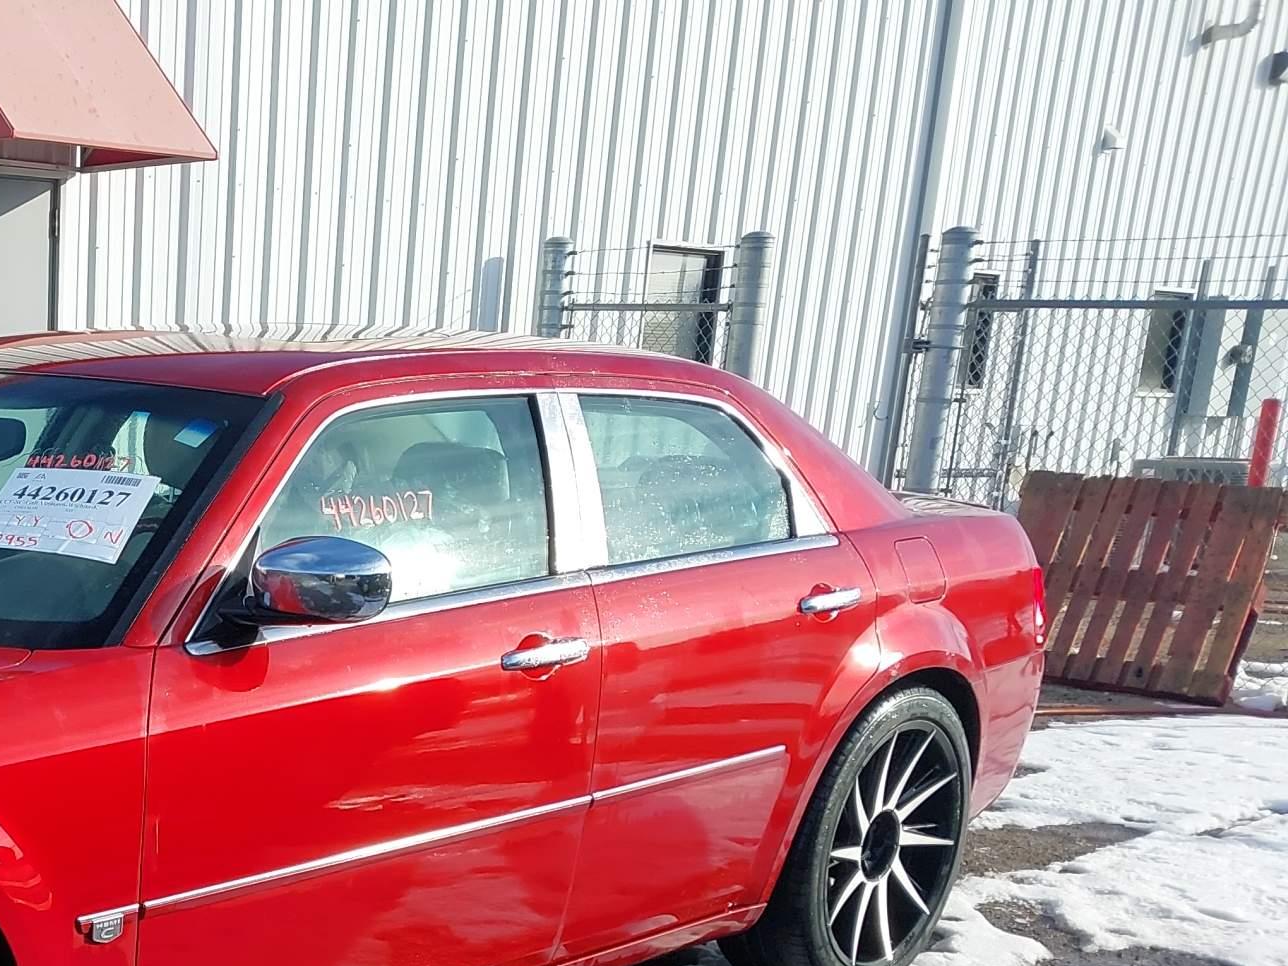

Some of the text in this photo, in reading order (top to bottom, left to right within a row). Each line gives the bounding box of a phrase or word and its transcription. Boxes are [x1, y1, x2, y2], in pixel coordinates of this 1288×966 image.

[27, 454, 131, 472] 44260127
[13, 485, 132, 507] 44260127
[320, 490, 433, 531] 44260127
